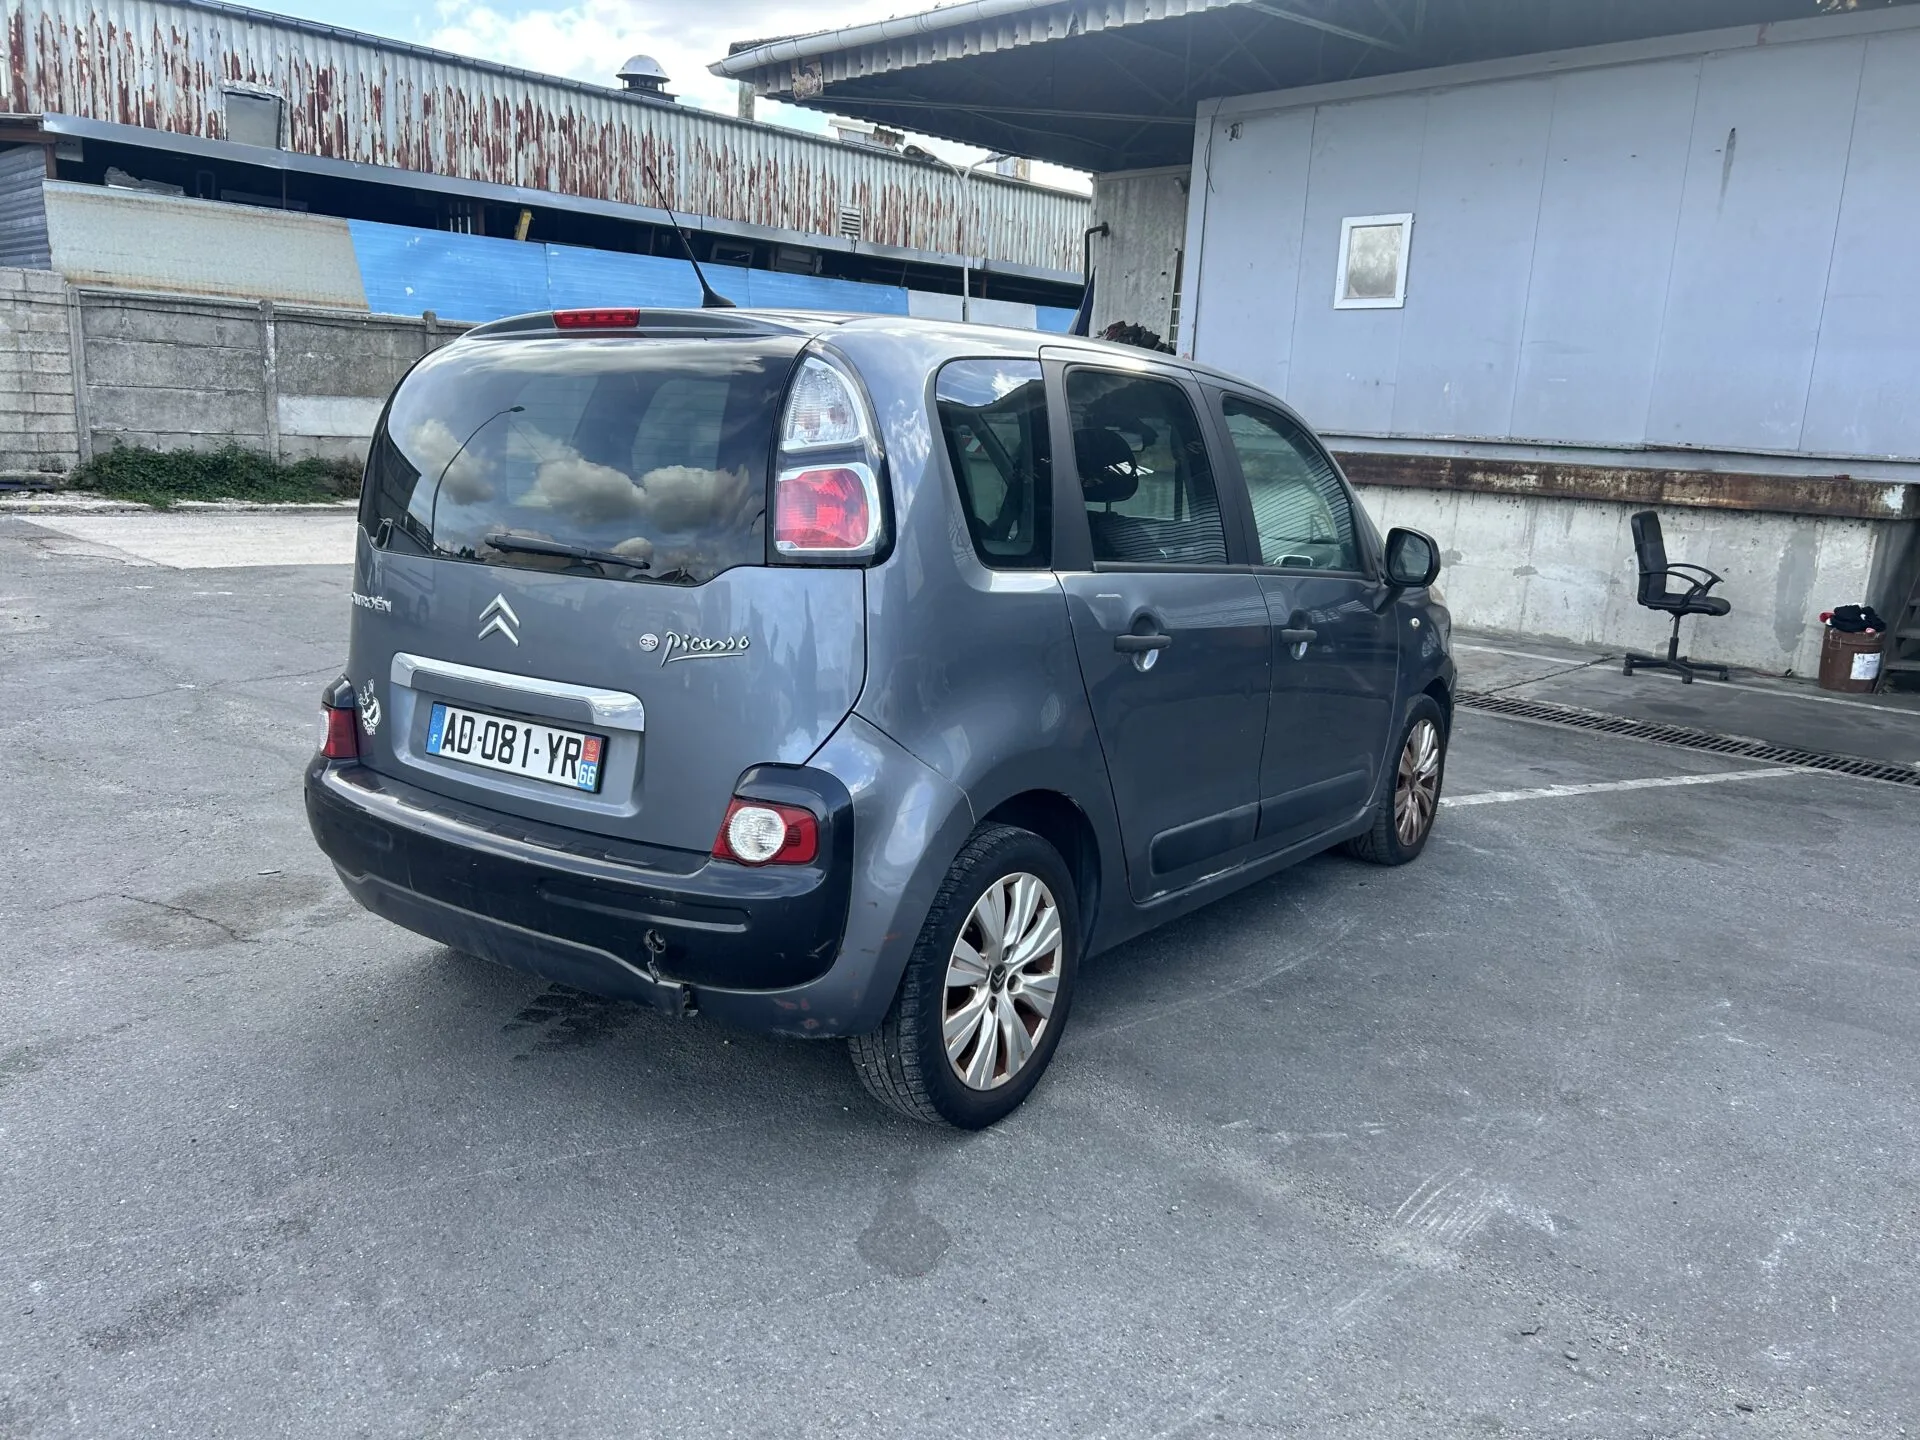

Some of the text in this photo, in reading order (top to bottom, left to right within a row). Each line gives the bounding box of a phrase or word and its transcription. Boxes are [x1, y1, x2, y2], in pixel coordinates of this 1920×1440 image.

[660, 631, 751, 668] Picasso
[431, 733, 438, 745] F
[441, 712, 582, 780] AD-081-YR
[578, 764, 597, 786] 66
